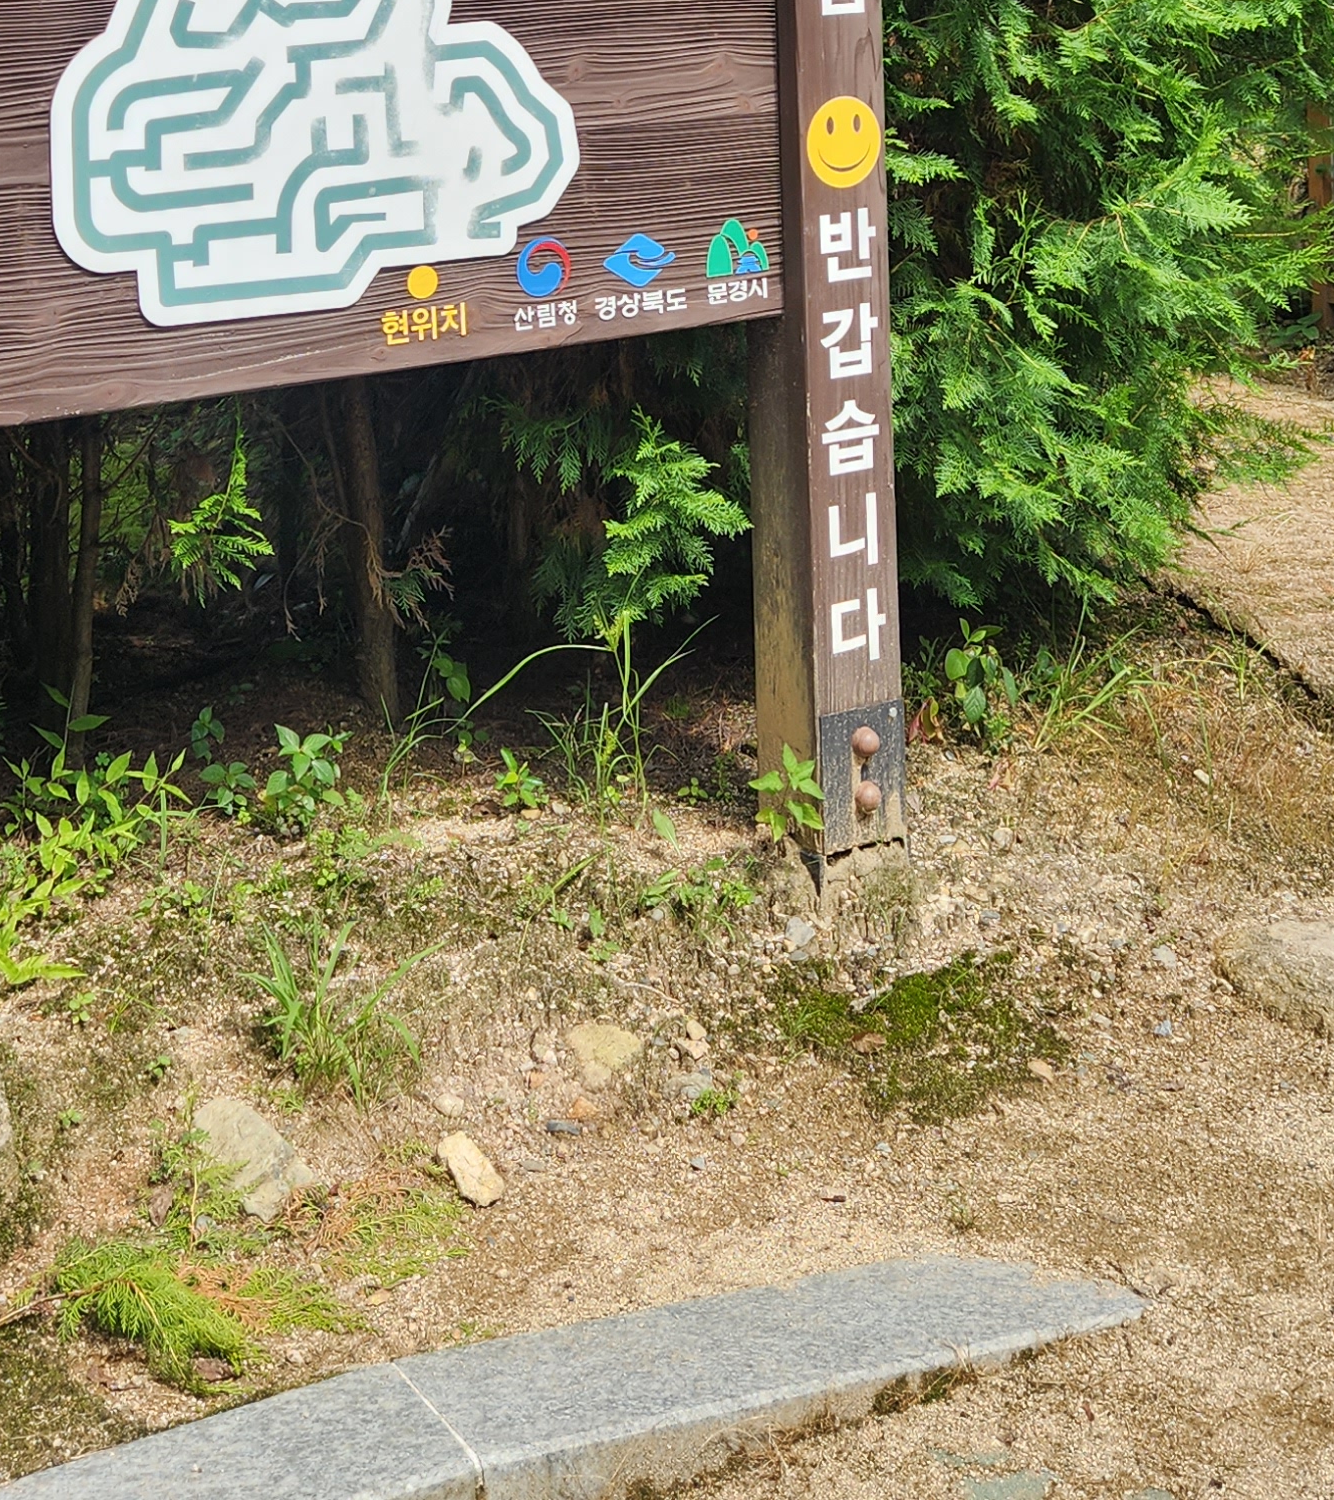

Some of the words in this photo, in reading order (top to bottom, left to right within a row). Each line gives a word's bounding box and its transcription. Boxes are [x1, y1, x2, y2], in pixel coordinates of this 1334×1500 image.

[594, 288, 688, 321] 경상북도
[707, 277, 768, 306] 문경시
[380, 302, 468, 347] 현위치
[513, 300, 578, 331] 산림청
[818, 207, 886, 661] 반갑습니다
